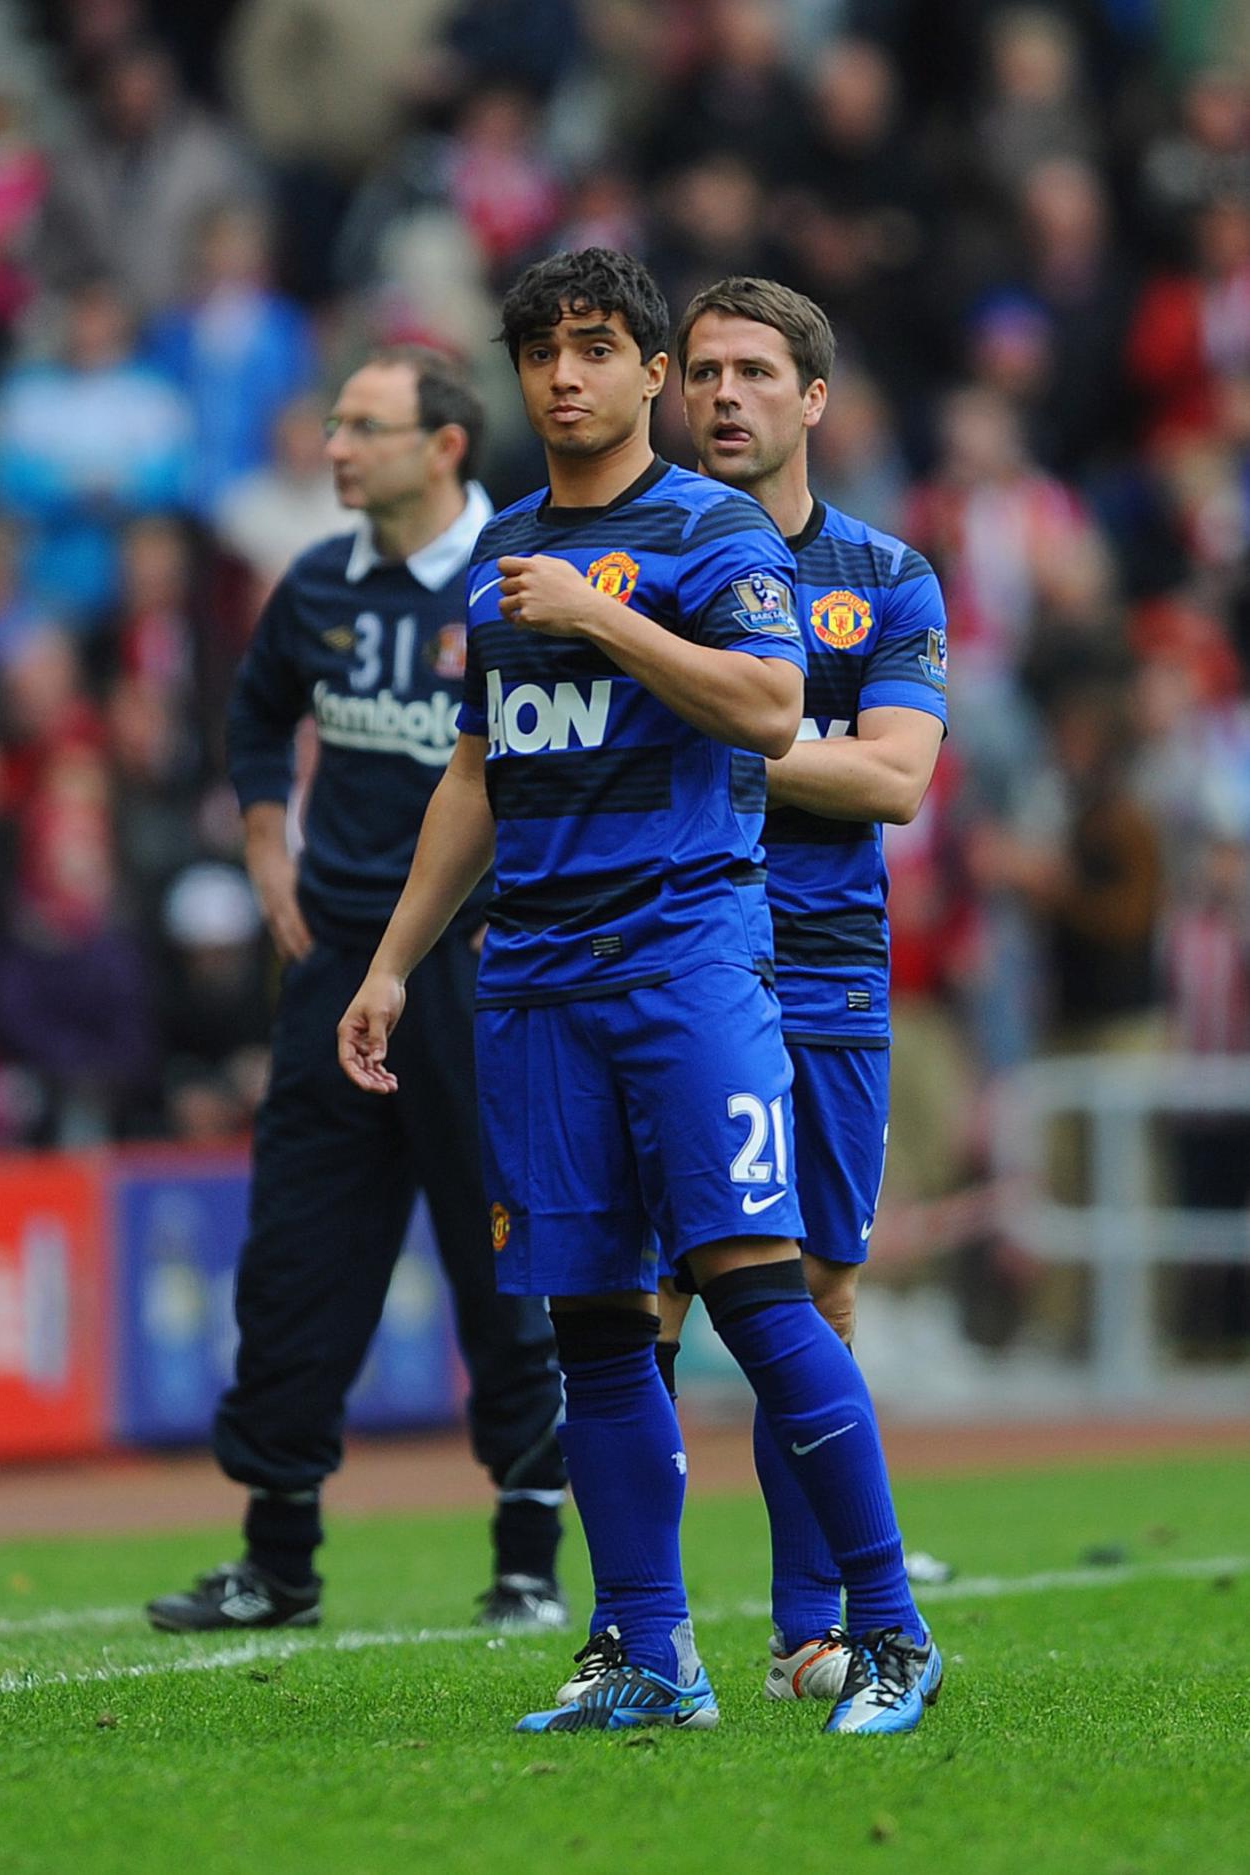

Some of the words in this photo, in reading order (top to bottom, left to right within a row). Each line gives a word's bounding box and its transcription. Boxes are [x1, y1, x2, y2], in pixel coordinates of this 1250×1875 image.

[814, 591, 869, 613] MANCHESTER
[349, 612, 415, 691] 31
[485, 668, 613, 760] AON
[727, 1092, 787, 1185] 21
